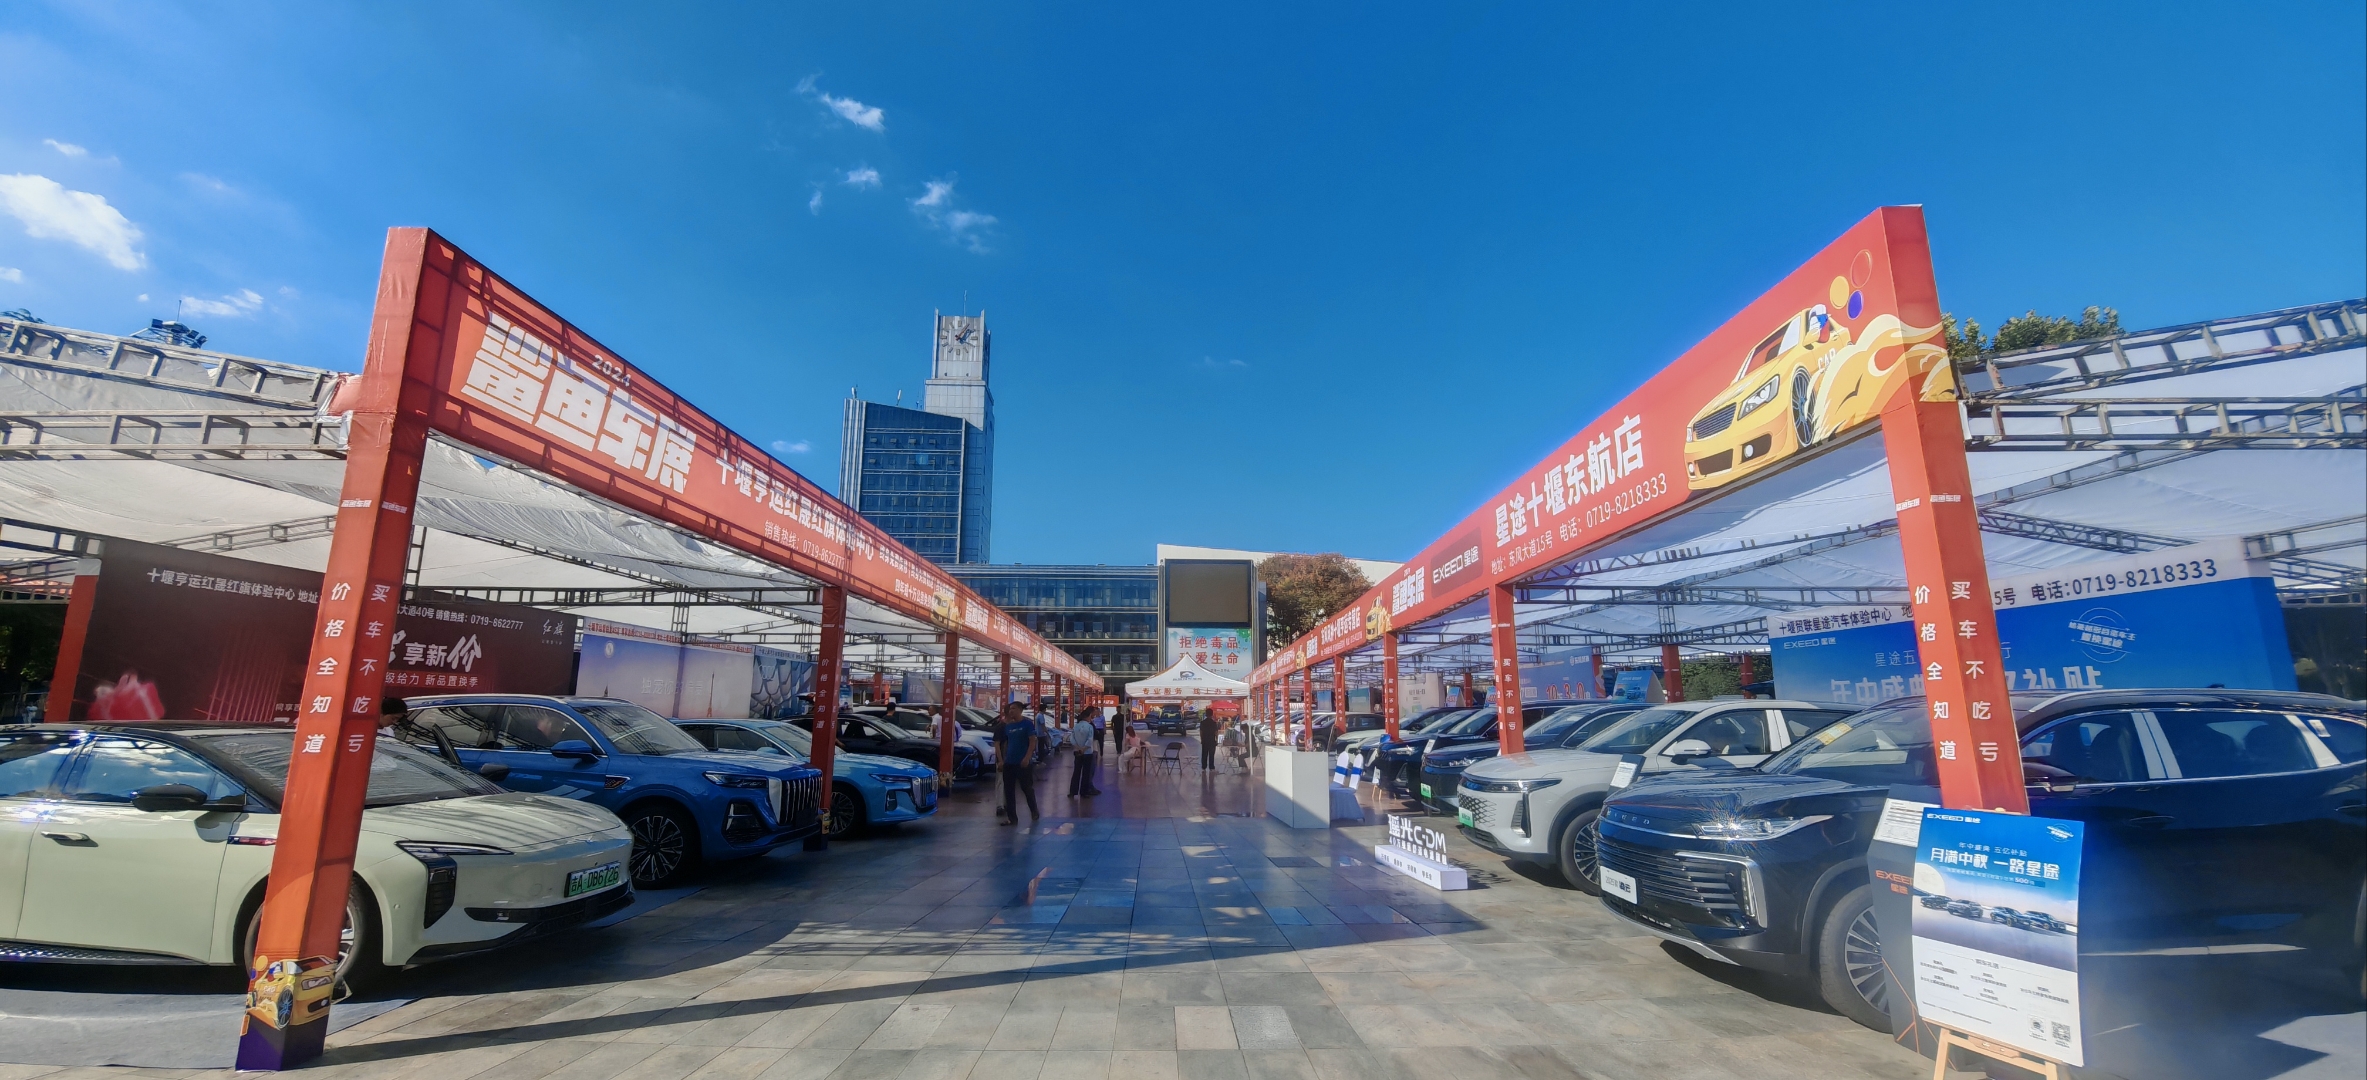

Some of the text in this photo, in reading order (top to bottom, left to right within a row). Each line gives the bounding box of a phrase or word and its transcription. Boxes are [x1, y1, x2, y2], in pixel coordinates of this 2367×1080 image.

[592, 355, 632, 386] 2024
[461, 311, 697, 494] 鲨鱼车展
[1495, 414, 1644, 548] 星途十堰东航店
[1432, 546, 1479, 584] EXEED 星途
[1392, 566, 1425, 616] 鲨鱼车展
[397, 603, 435, 618] 大道40号
[1179, 636, 1239, 649] 拒绝毒品
[1784, 638, 1820, 649] EXEED
[302, 582, 351, 753] 价格全知道
[348, 584, 391, 753] 买车不吃亏
[425, 674, 479, 687] 新品置换季
[1914, 585, 1957, 761] 价格全知道
[1952, 581, 1999, 762] 买车不吃亏
[1142, 687, 1182, 695] 专业服务
[1502, 658, 1516, 731] 买车不吃亏
[1926, 813, 1964, 823] EXEED
[1930, 846, 2060, 881] 月满中秋 一路星途
